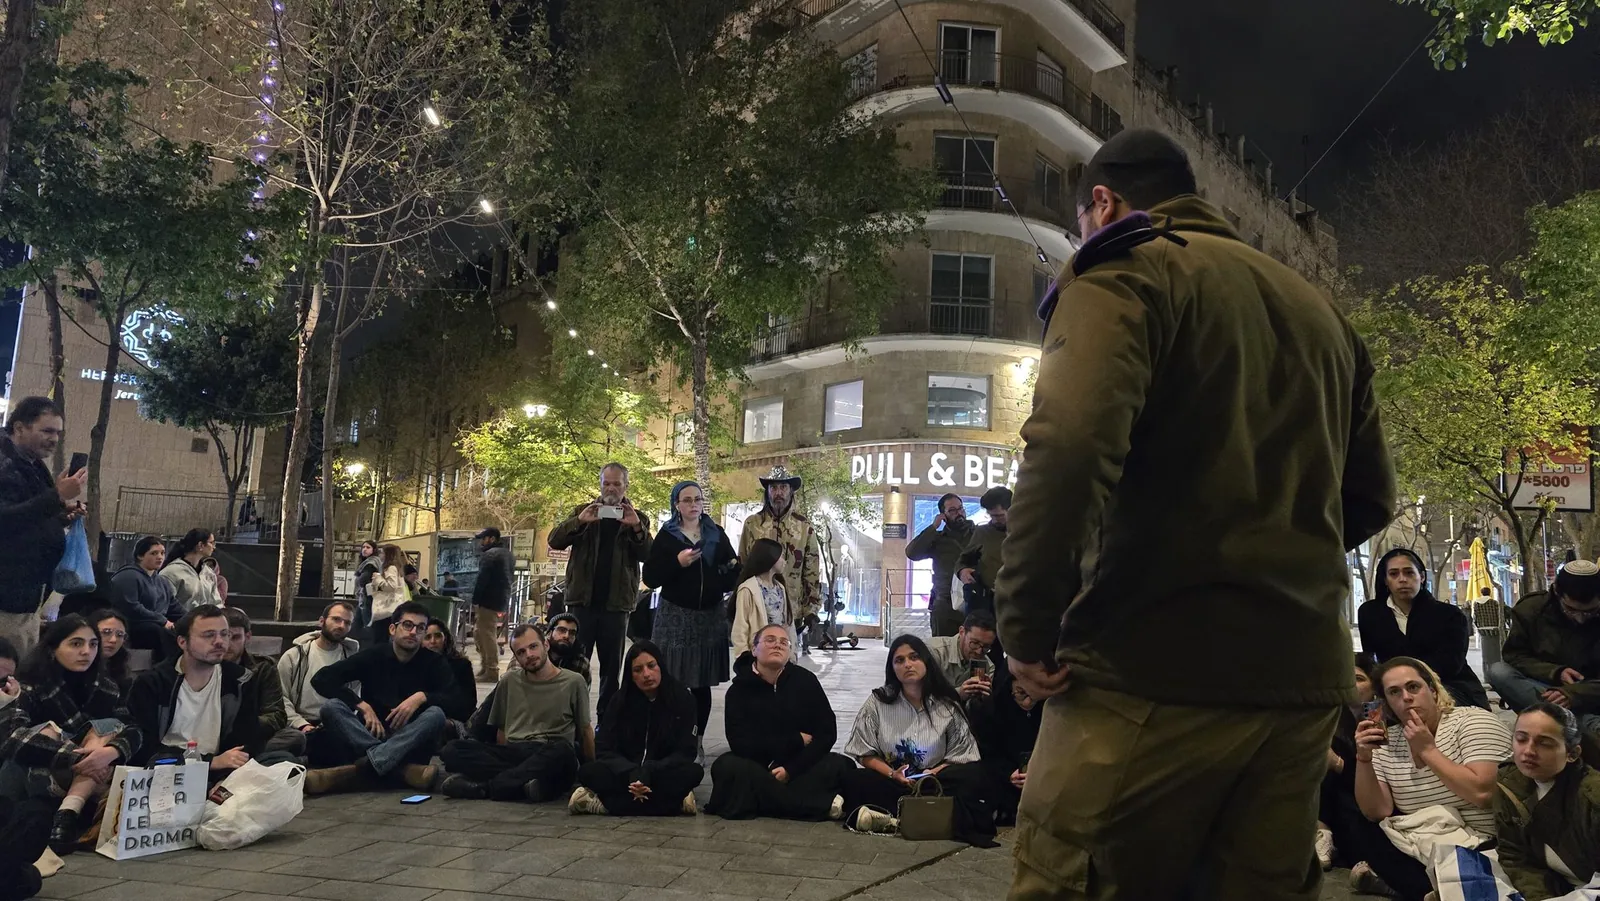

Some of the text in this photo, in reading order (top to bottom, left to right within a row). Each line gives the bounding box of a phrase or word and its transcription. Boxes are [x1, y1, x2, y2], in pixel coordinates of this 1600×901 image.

[81, 369, 142, 385] HEER
[114, 389, 142, 401] Jeru
[851, 452, 1019, 489] PULL & BEA
[130, 773, 184, 791] ME
[127, 791, 187, 812] PAA
[126, 815, 151, 831] LE
[124, 827, 194, 851] DRAMA
